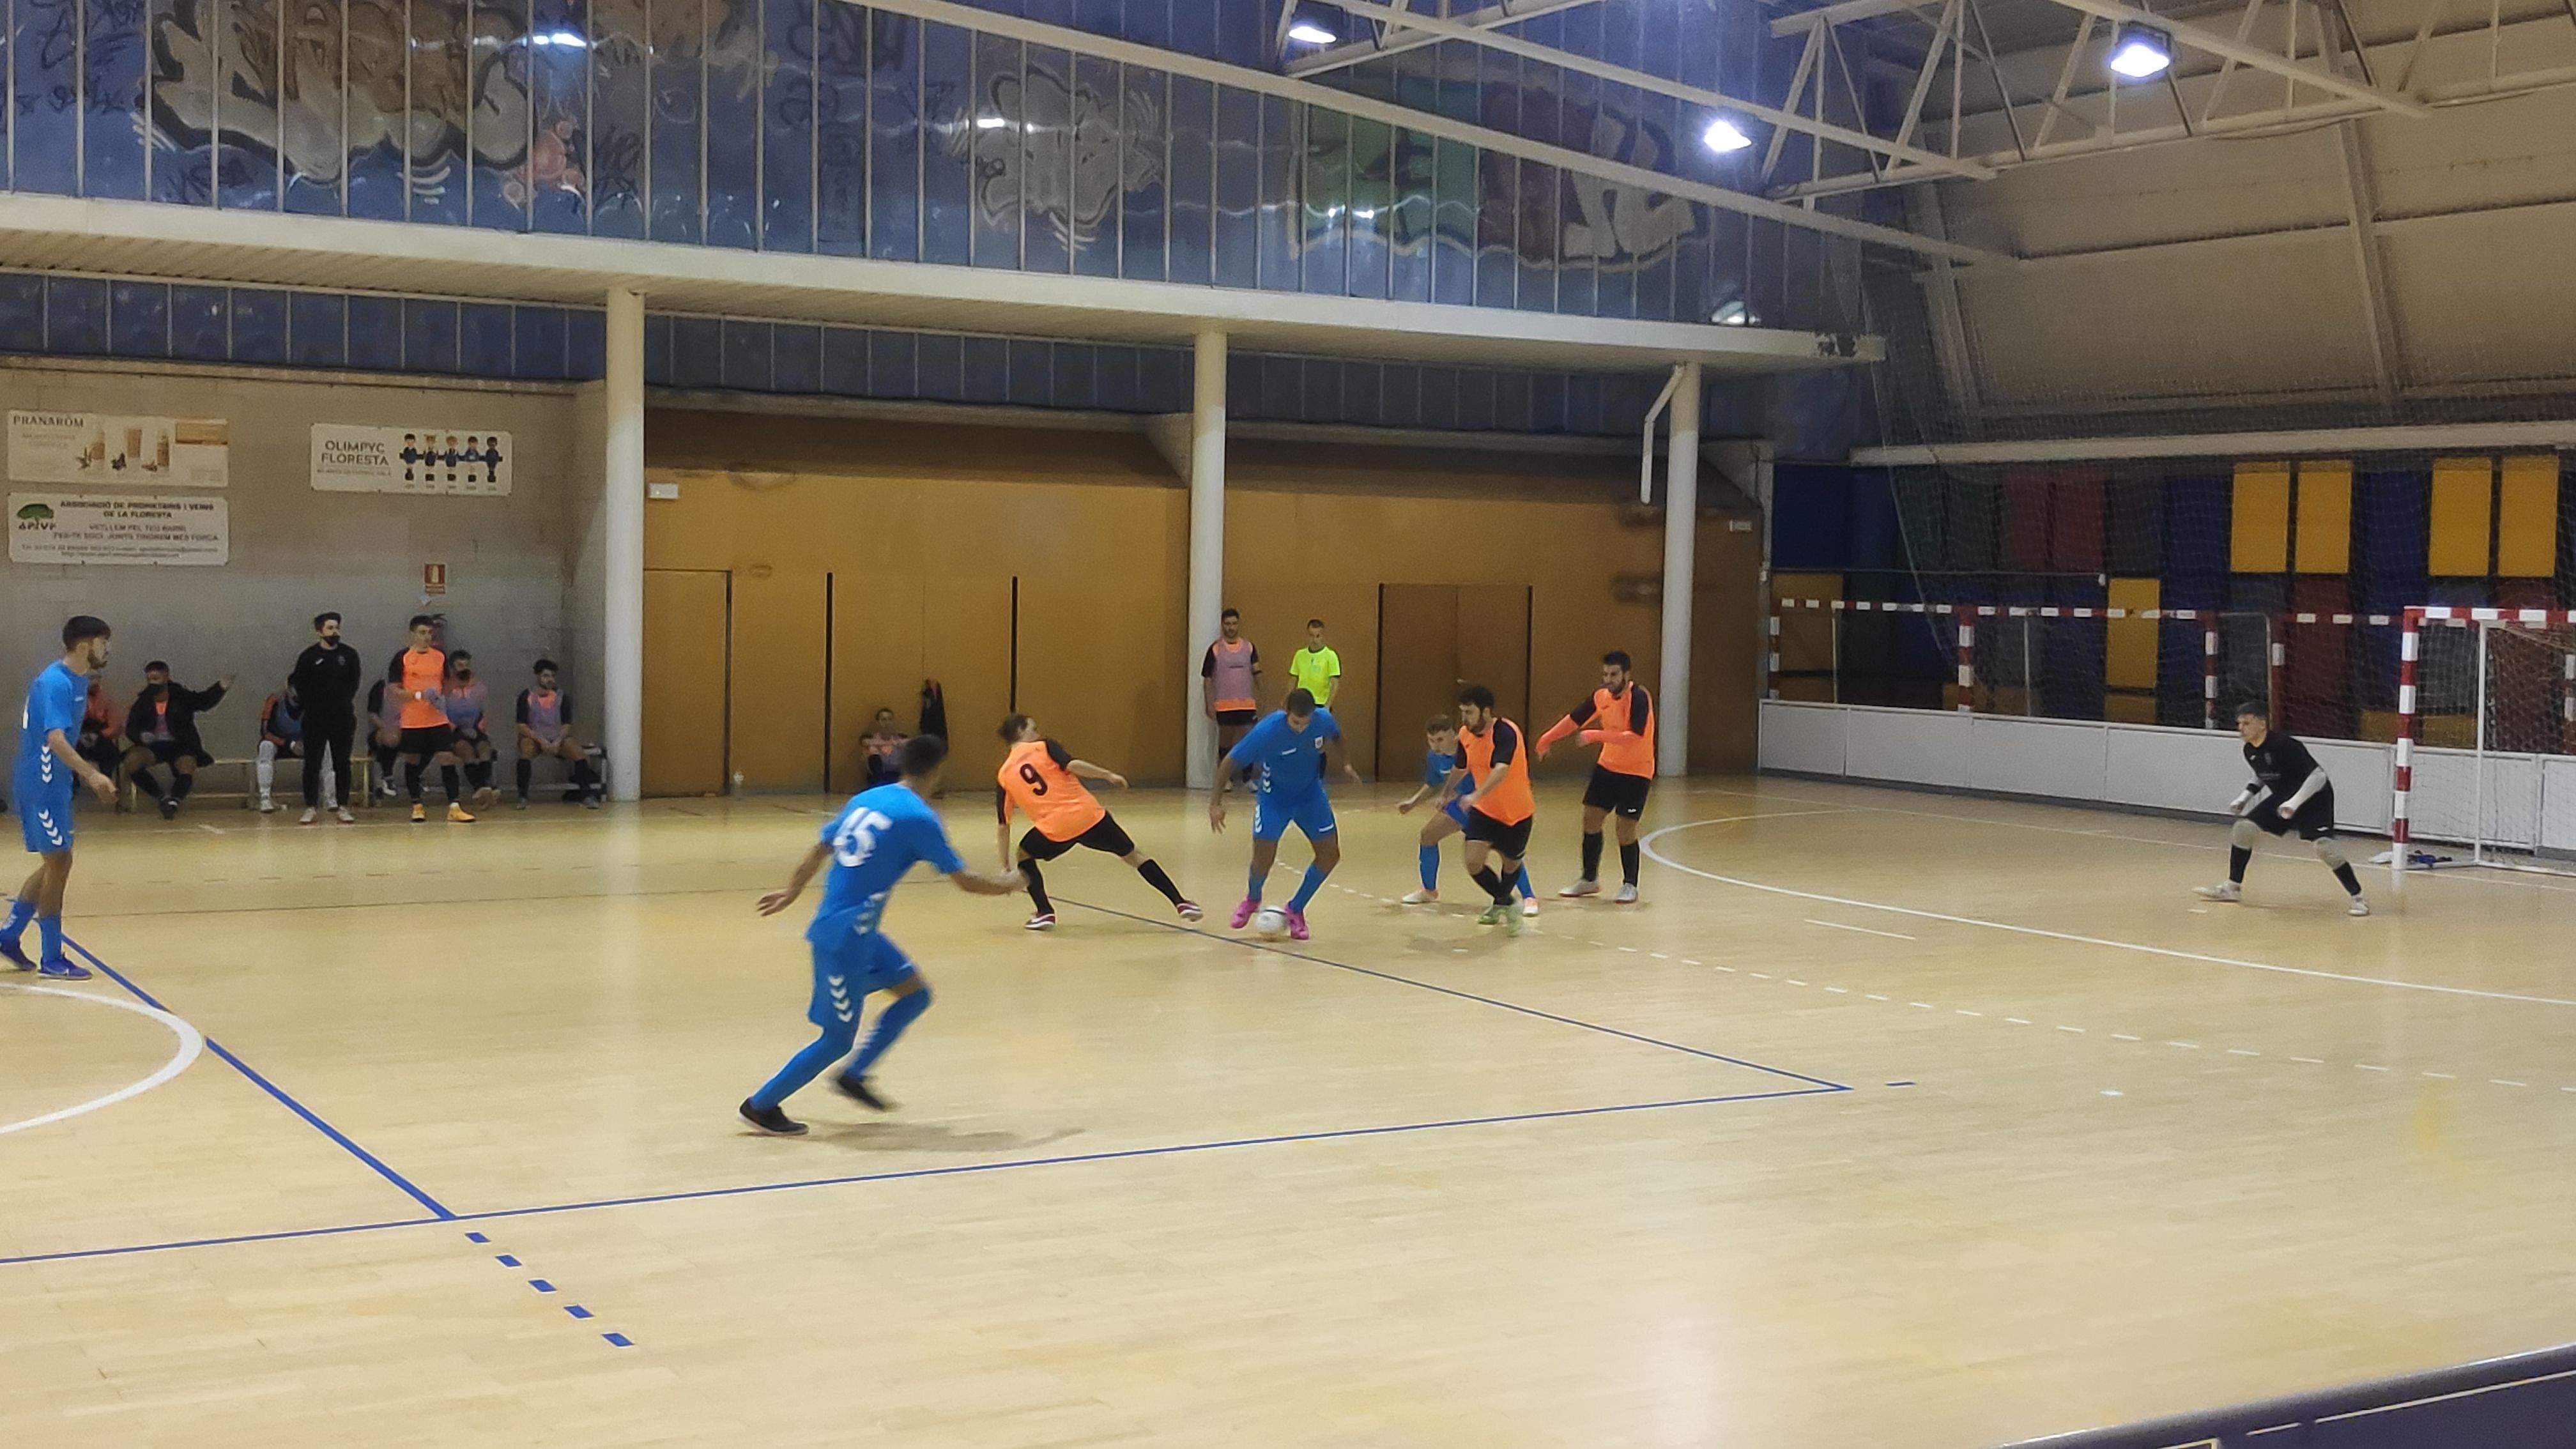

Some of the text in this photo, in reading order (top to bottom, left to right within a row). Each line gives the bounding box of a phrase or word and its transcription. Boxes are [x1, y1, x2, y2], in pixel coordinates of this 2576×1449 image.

[325, 440, 385, 454] OLIMPYC
[321, 452, 389, 466] FLORESTA
[1020, 763, 1048, 796] 9
